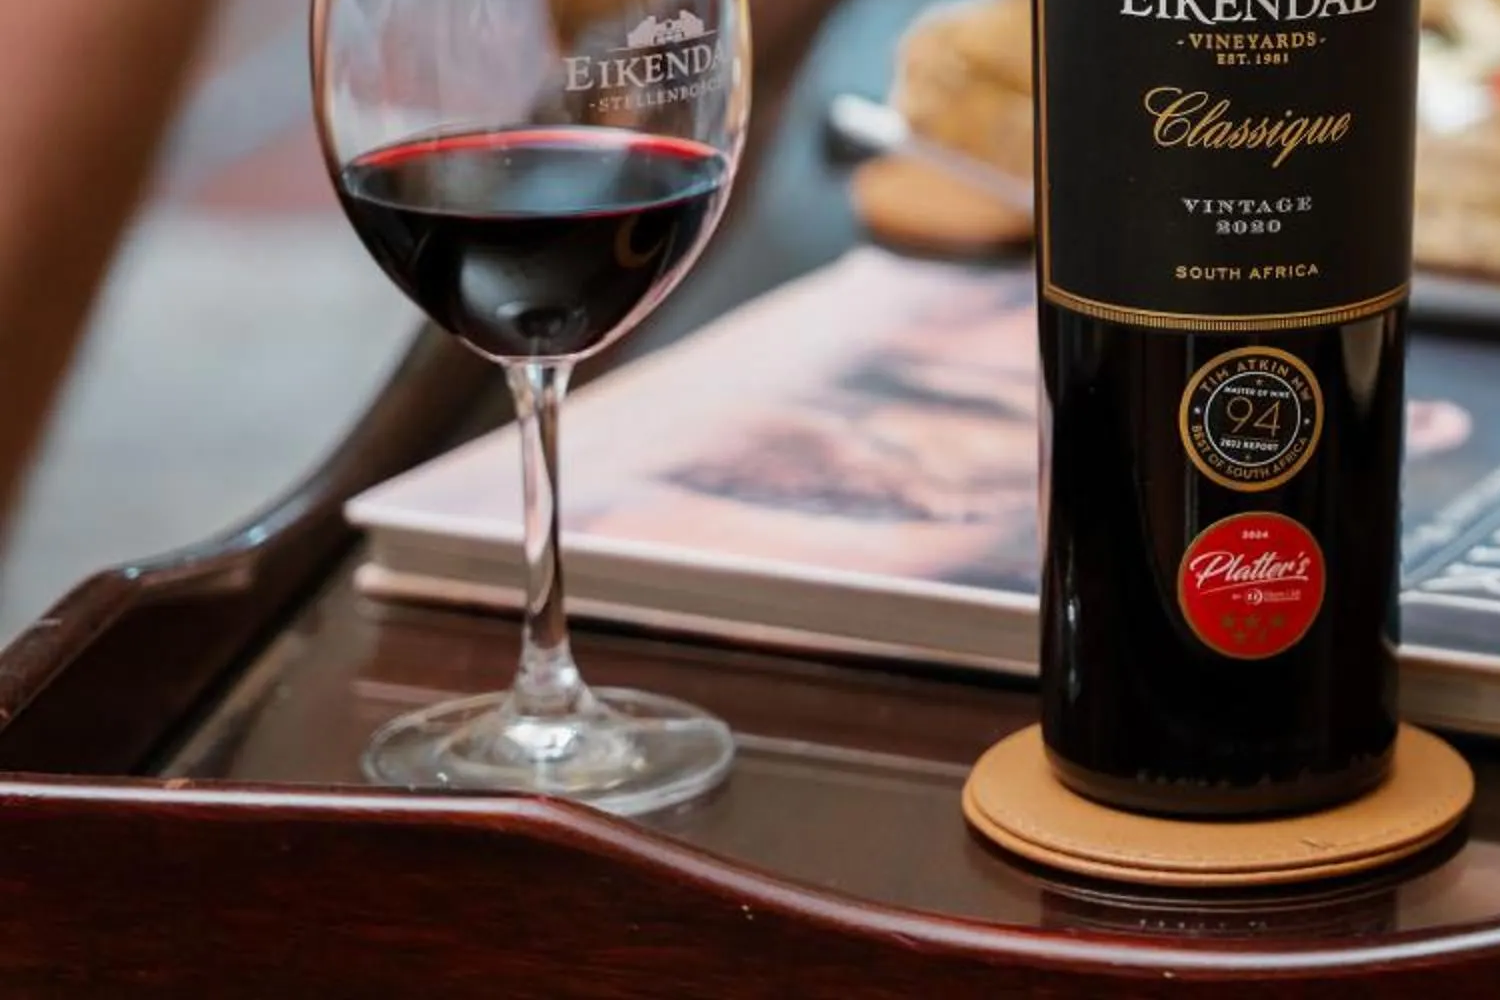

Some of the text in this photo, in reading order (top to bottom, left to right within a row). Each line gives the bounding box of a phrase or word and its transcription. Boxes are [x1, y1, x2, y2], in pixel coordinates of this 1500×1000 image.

[563, 38, 725, 91] EIKENDA
[1216, 53, 1290, 66] EST. 1981
[1144, 86, 1351, 169] Classique
[1181, 196, 1313, 215] VINTAGE
[1215, 219, 1282, 235] 2020
[1175, 263, 1320, 281] SOUTH AFRICA
[1200, 368, 1230, 394] TIM
[1236, 358, 1290, 378] ATKIN
[1226, 396, 1281, 438] 94
[1208, 453, 1225, 469] OF
[1225, 465, 1270, 480] SOUTH
[1272, 437, 1309, 474] AFRICA
[1189, 551, 1312, 590] Platter's
